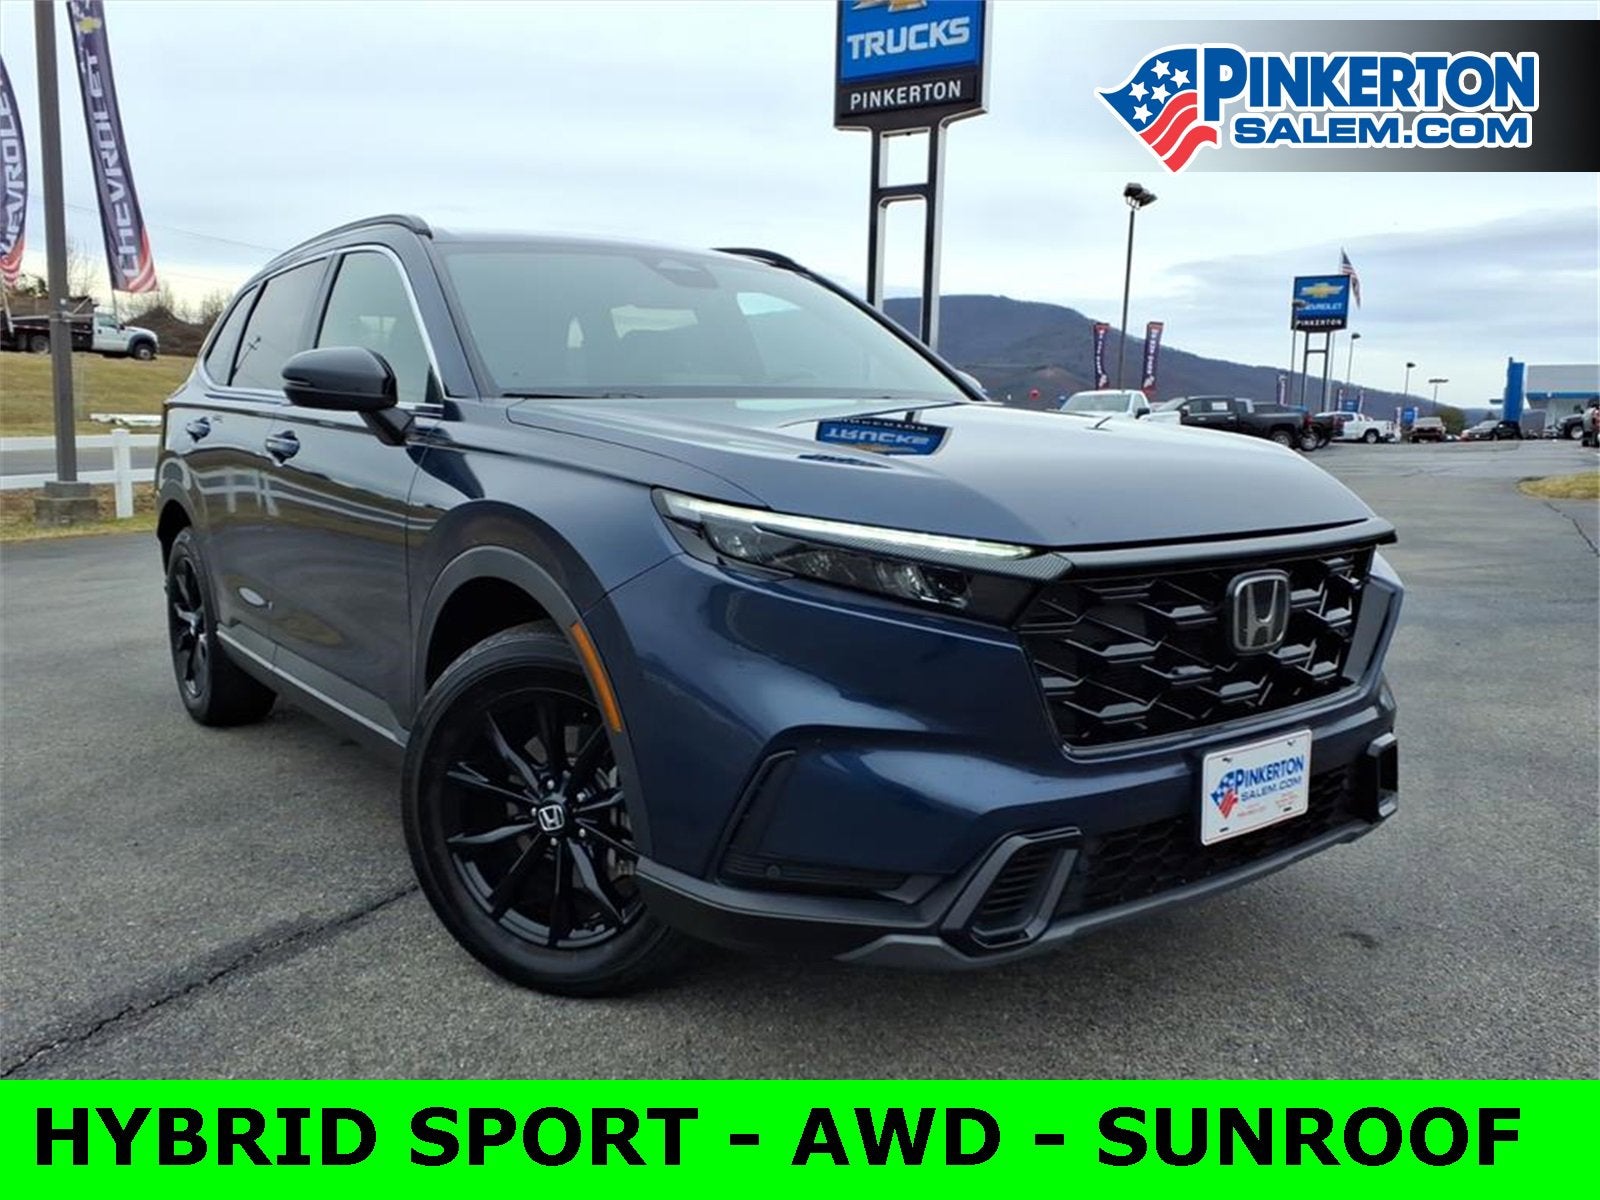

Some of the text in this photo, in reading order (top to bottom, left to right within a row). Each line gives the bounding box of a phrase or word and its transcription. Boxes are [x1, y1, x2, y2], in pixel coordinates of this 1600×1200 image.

[846, 15, 971, 60] TRUCKS
[850, 80, 962, 111] PINKERTON
[82, 50, 139, 278] CHEVROLET
[1235, 754, 1305, 793] PINKERTON
[1240, 775, 1303, 802] SALEM.COM
